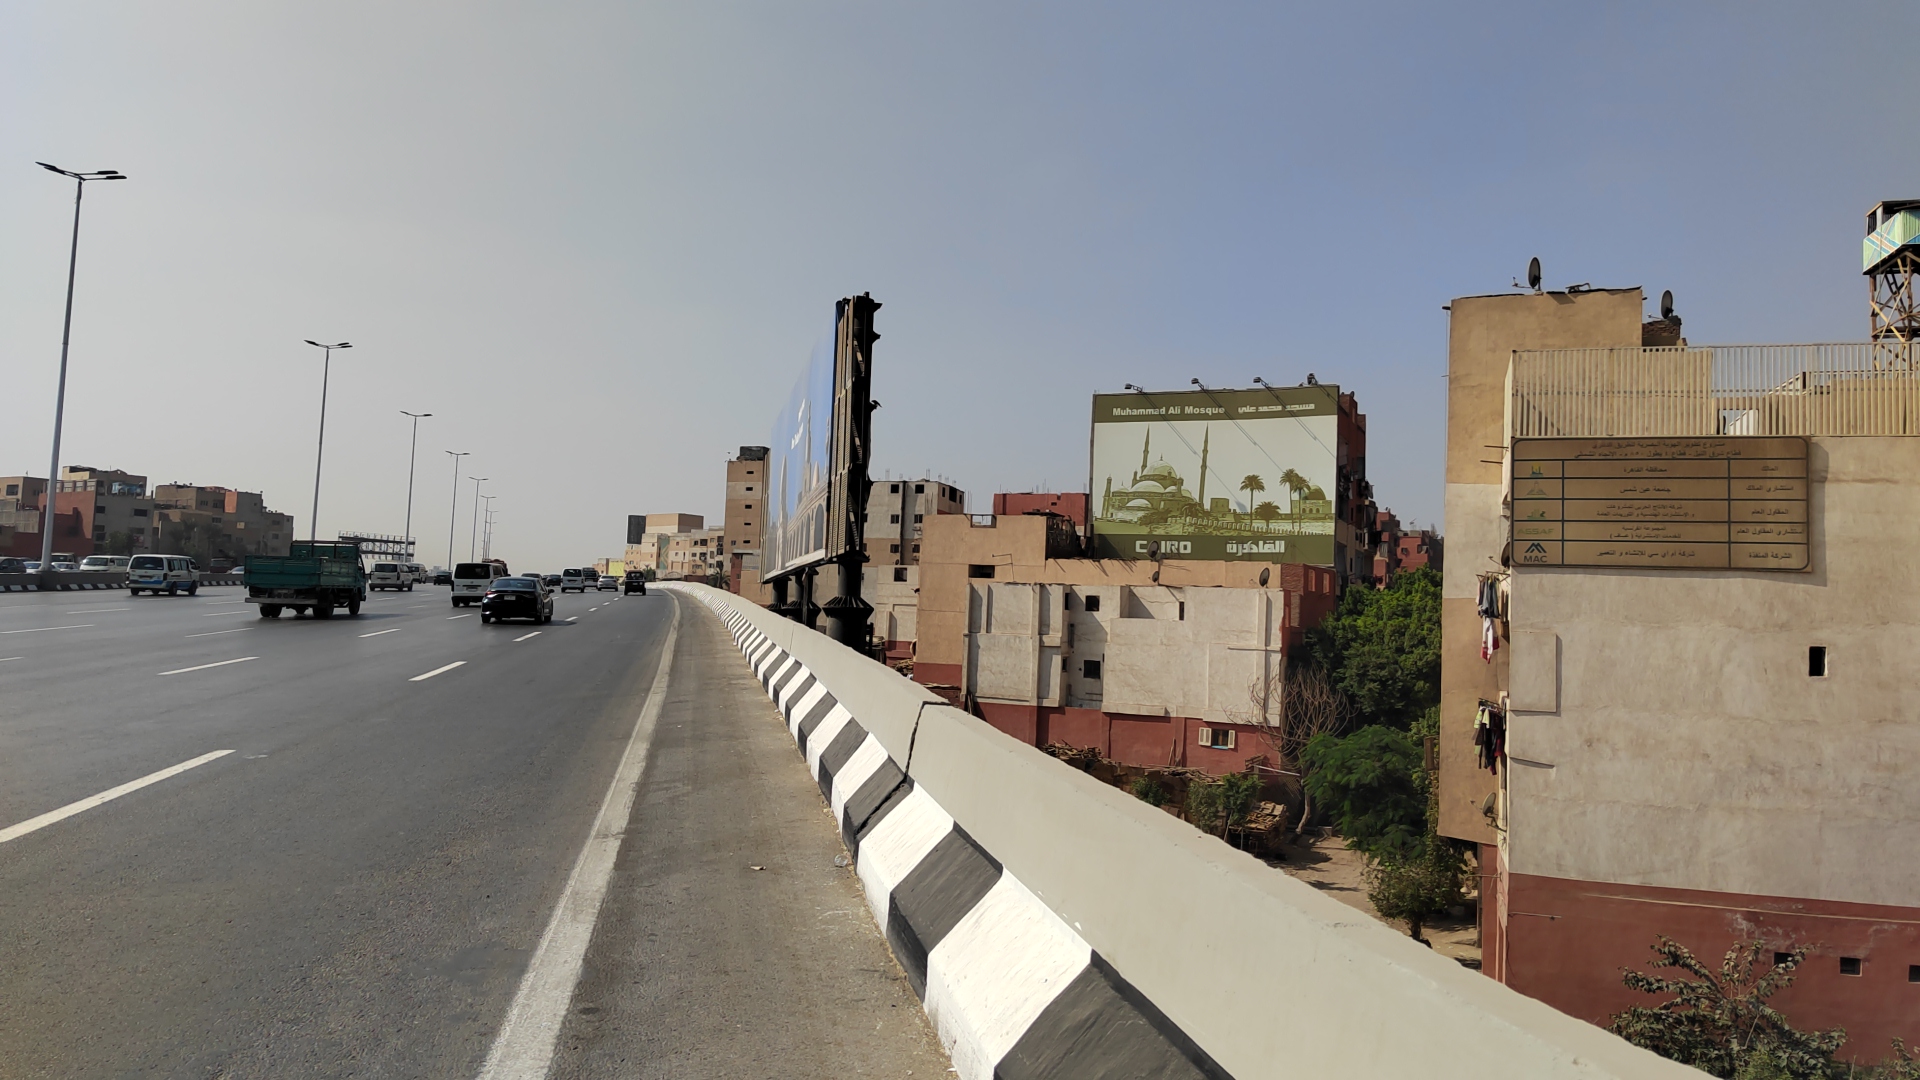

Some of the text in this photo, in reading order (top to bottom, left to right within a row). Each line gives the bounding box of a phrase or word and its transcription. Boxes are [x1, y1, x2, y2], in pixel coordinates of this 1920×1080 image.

[1112, 405, 1225, 416] Muhammad Ali Mosque
[1237, 405, 1256, 414] علي
[1284, 403, 1315, 412] مسجد
[1135, 540, 1192, 554] CIRO
[1226, 540, 1285, 557] القاهرة
[1523, 555, 1548, 563] MAC
